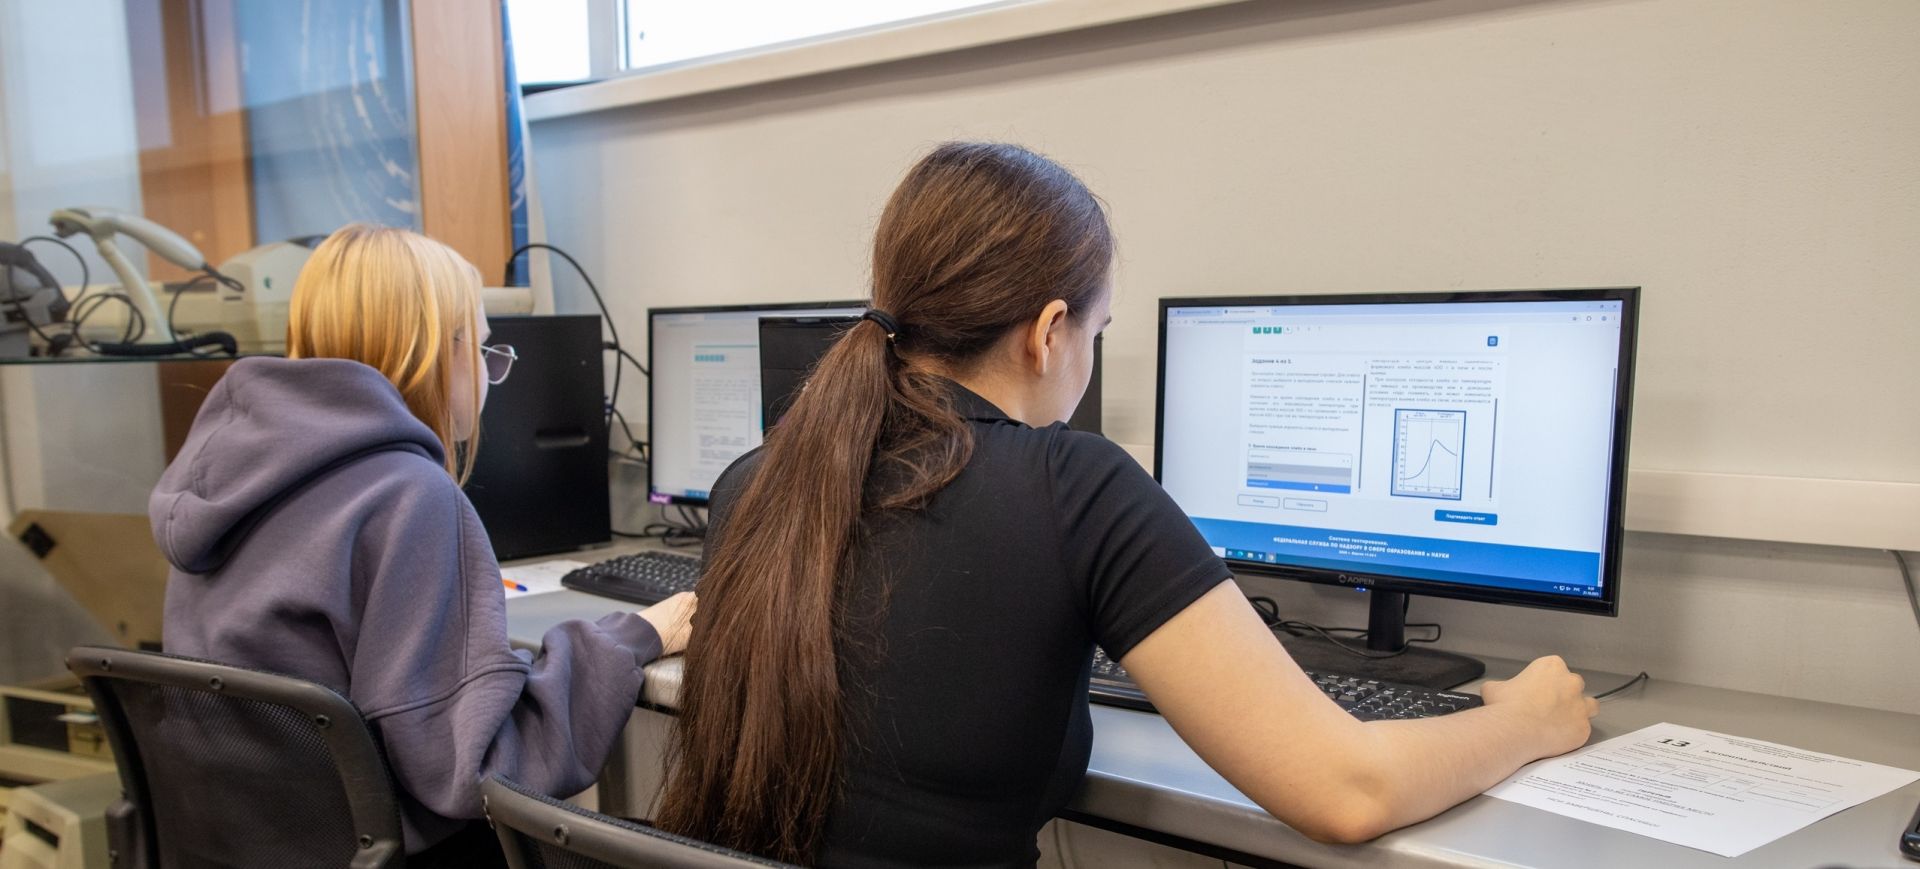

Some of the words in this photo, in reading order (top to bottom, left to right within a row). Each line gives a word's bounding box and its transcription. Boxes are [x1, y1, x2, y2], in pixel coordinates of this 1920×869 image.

[1273, 536, 1308, 545] ФЕДЕРАЛЬНАЯ
[1386, 547, 1426, 557] ОБРАЗОВАНИЯ
[1347, 576, 1375, 585] AOPEN
[1656, 738, 1691, 748] 13
